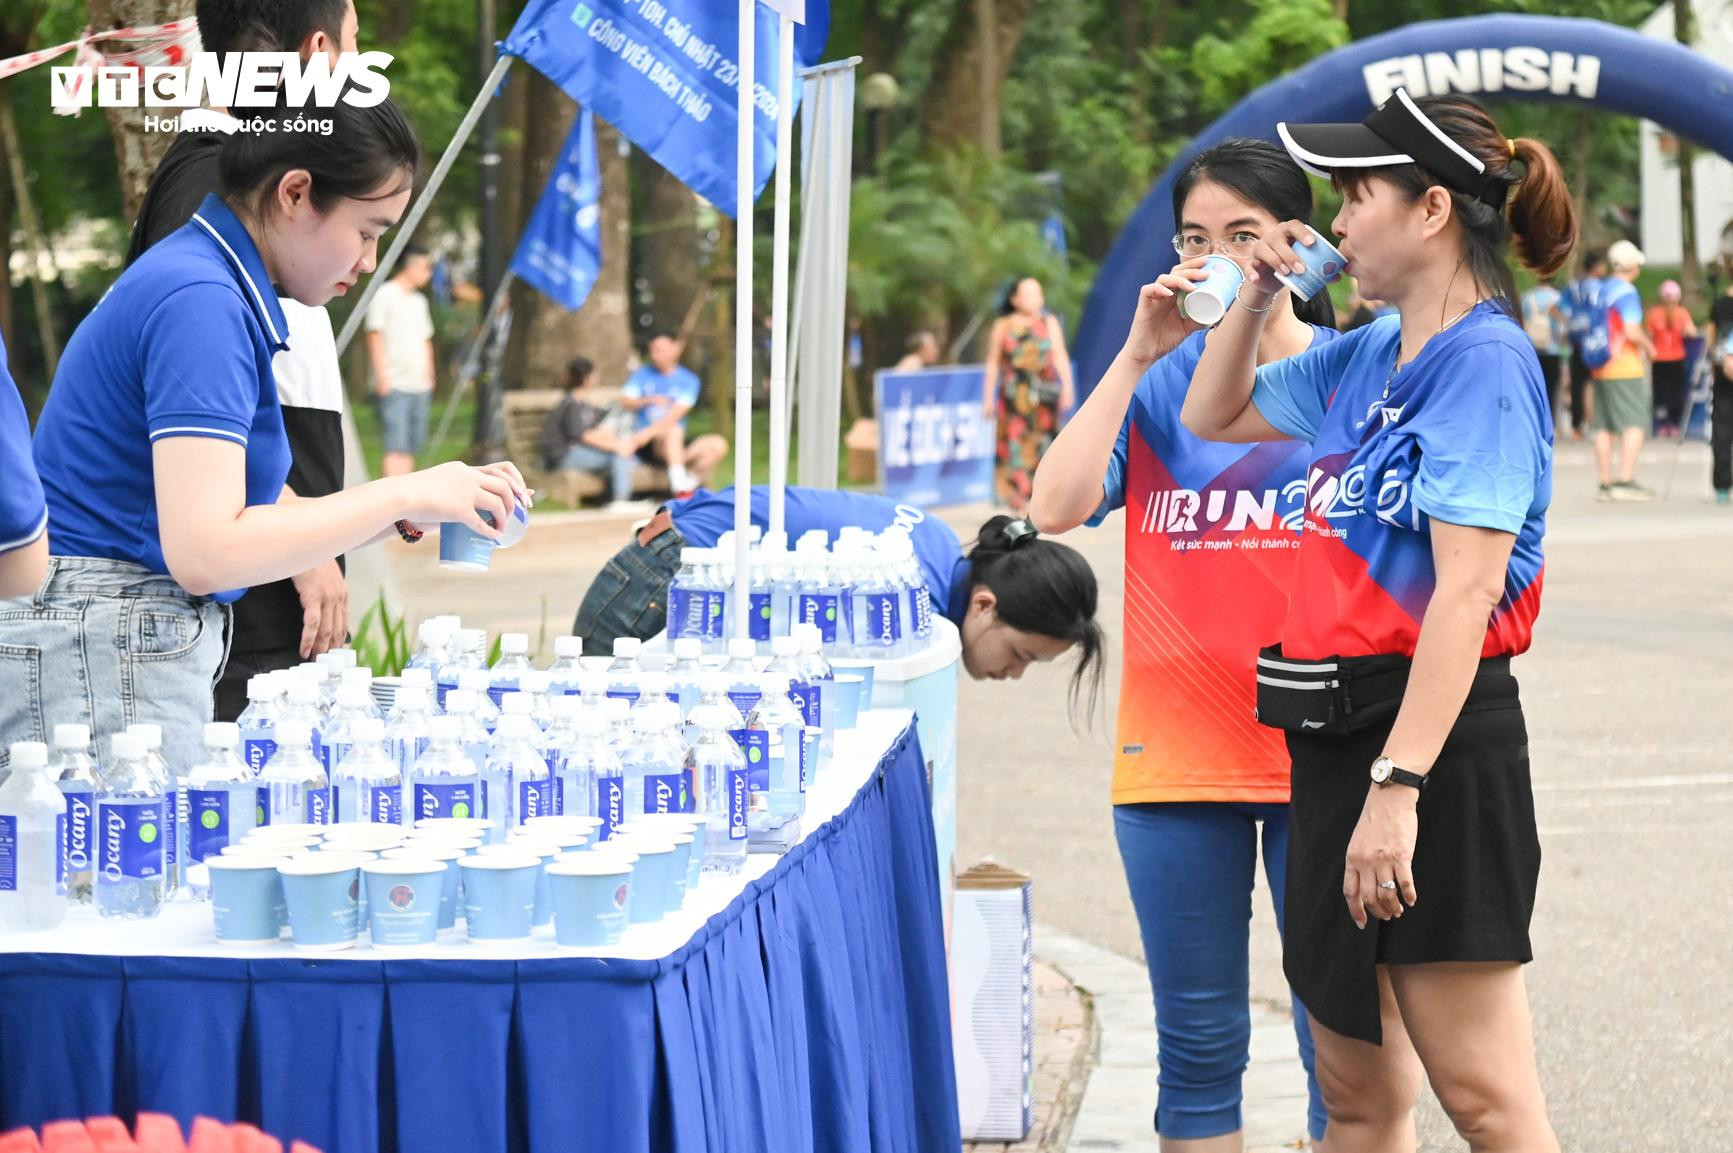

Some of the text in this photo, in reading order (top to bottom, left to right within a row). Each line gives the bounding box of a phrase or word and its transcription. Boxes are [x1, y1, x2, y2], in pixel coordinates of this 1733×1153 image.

[588, 18, 713, 122] CÔNG VIÊN BÁCH THẢO
[1362, 46, 1601, 108] FINISH
[1204, 538, 1232, 551] mạnh
[1261, 538, 1289, 549] thành
[68, 797, 91, 868] Ocany
[733, 774, 745, 826] Ocany
[104, 808, 126, 882] Ocany
